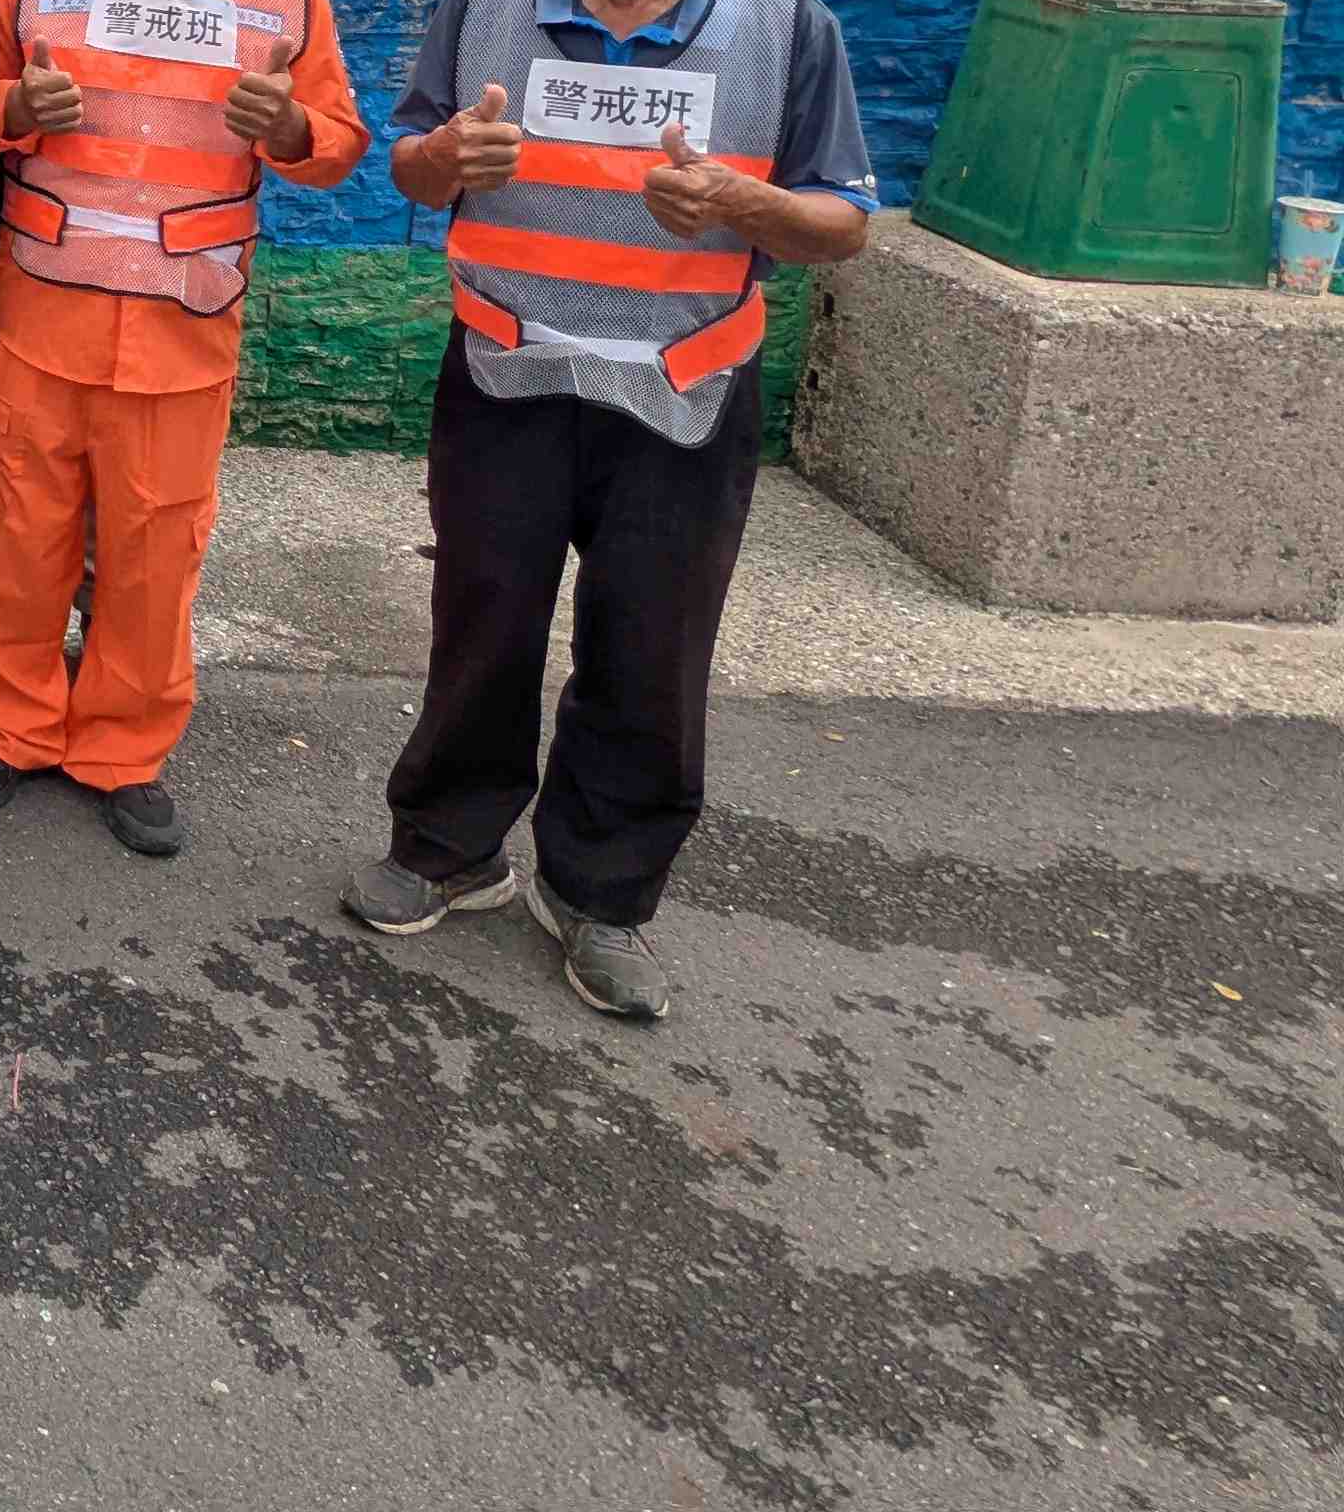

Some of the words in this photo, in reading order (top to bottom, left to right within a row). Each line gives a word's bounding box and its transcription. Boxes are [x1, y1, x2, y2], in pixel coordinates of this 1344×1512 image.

[103, 0, 224, 48] 警戒班
[541, 78, 695, 131] 警戒班
